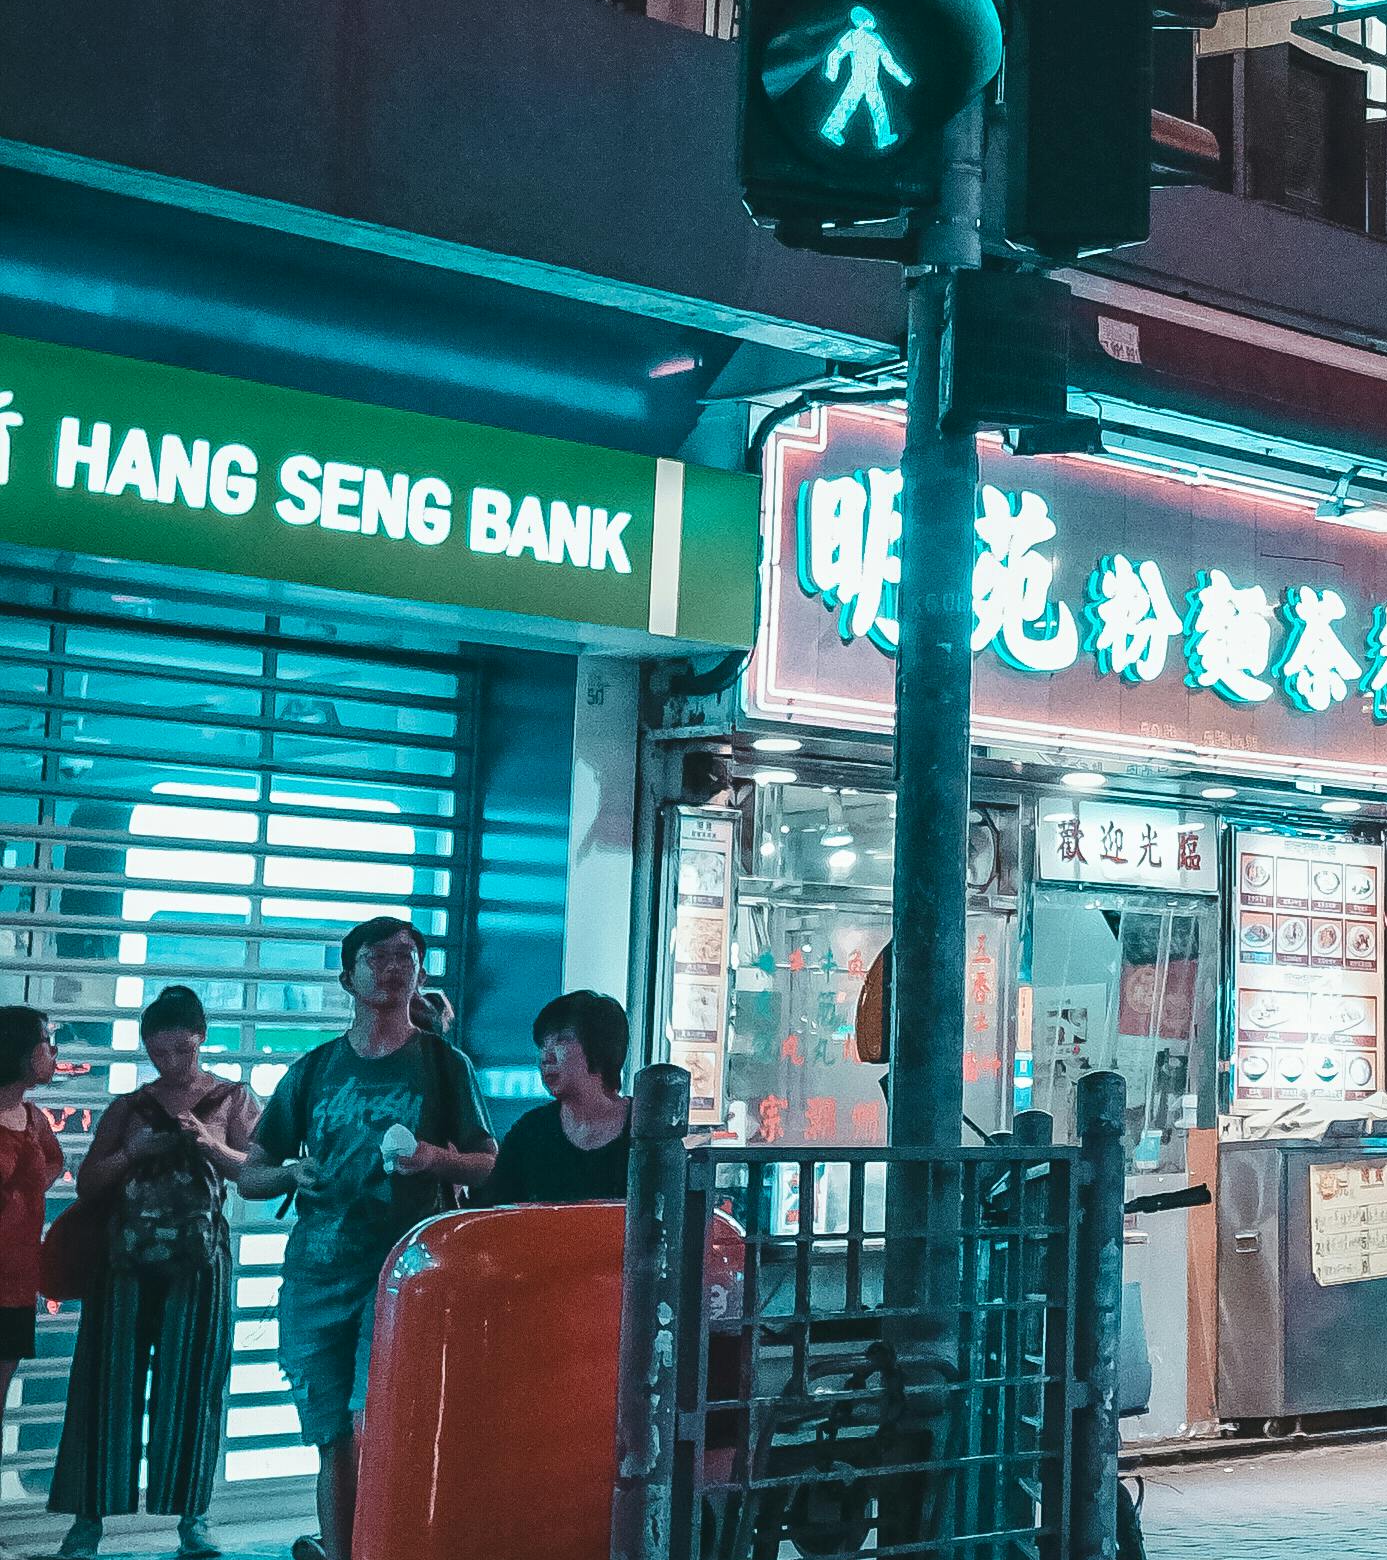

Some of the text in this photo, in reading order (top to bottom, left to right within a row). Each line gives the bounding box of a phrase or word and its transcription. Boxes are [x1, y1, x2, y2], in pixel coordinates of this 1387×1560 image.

[55, 417, 259, 515] HANG
[275, 455, 452, 546] SENG
[468, 486, 633, 574] BANK
[1057, 820, 1202, 872] 歡迎光臨
